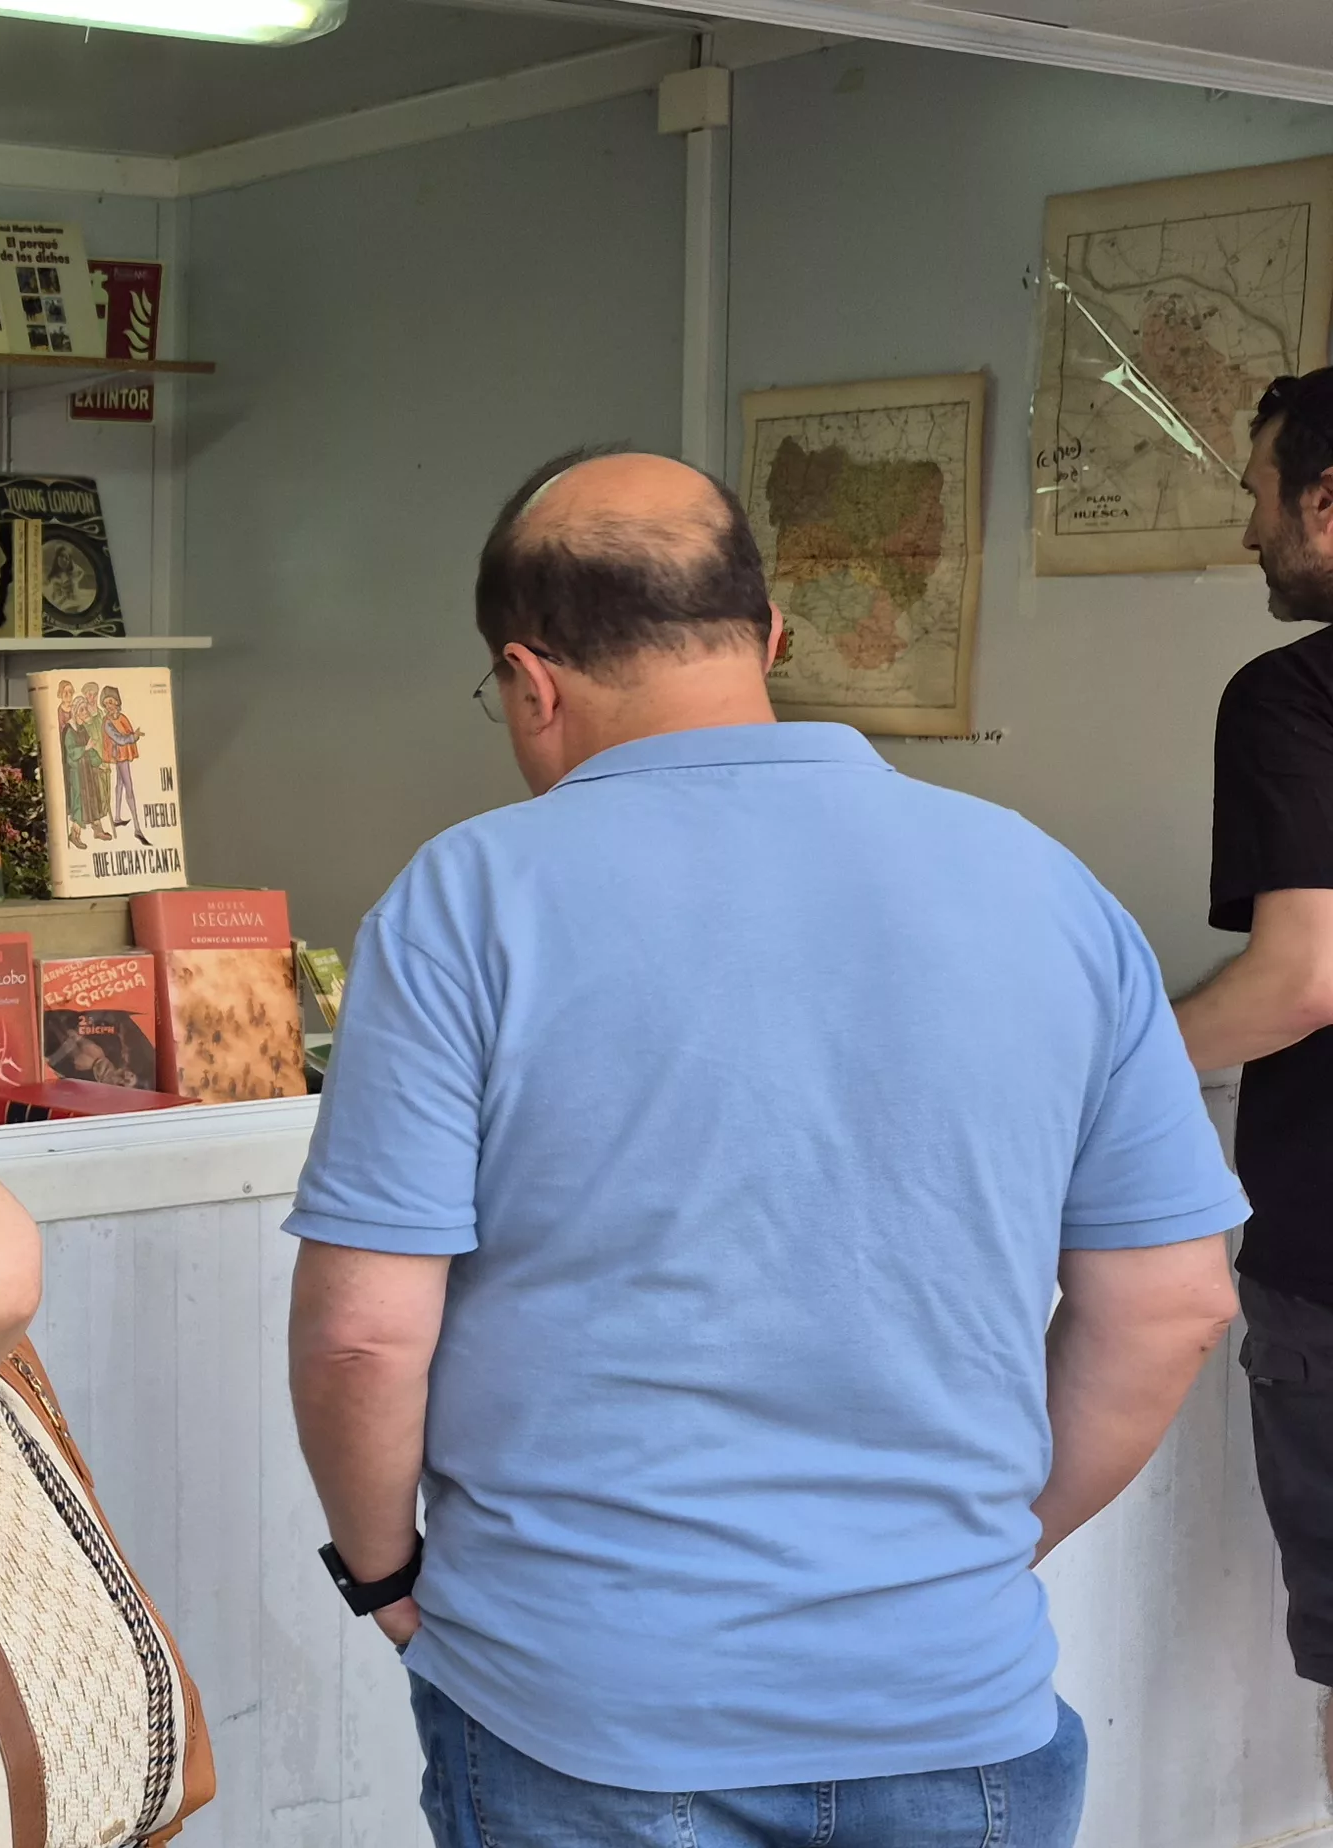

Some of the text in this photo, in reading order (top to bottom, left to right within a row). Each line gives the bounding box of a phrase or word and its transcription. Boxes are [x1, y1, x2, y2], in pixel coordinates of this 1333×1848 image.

[6, 237, 58, 252] El porqué
[0, 250, 70, 264] de los dichos
[75, 388, 150, 411] EXTINTOR
[4, 487, 96, 515] YOUNG LONDON
[1086, 494, 1122, 503] PLANO
[1073, 507, 1129, 520] HUESCA
[160, 767, 173, 792] UN
[144, 803, 178, 829] PUEBLO
[207, 901, 246, 910] MOSES
[192, 912, 265, 928] ISEGAWA
[42, 960, 83, 983] ARNOLD
[44, 960, 138, 1007] EL SARGENTO
